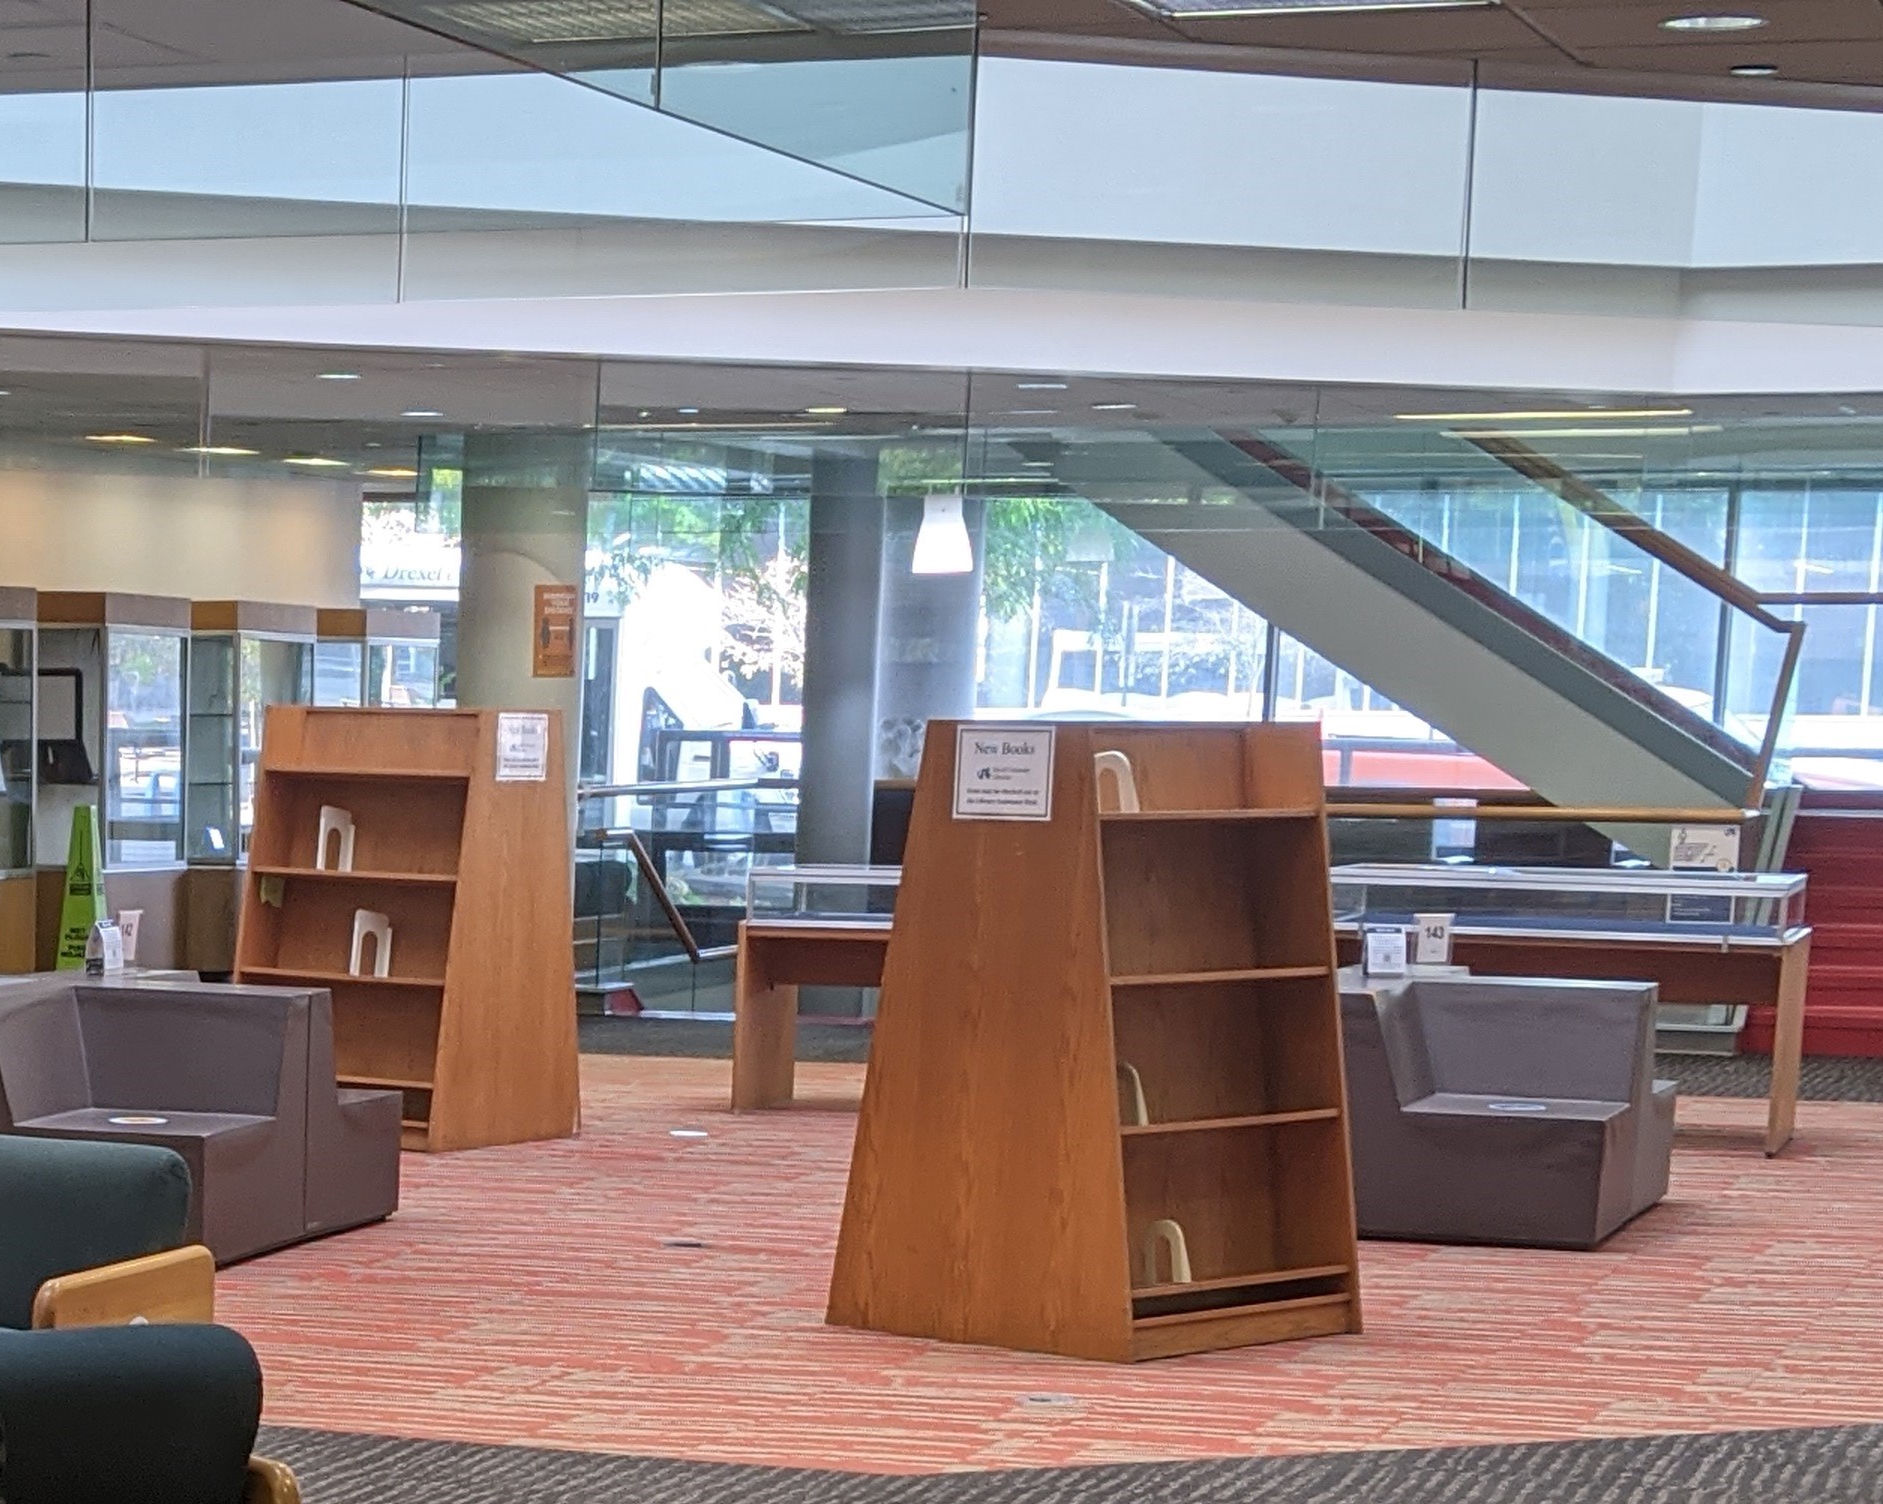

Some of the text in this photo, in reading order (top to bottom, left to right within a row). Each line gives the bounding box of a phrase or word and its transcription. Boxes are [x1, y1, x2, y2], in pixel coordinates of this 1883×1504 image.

[382, 566, 442, 581] Drexel
[974, 742, 1035, 755] New Books
[1425, 926, 1445, 939] 143
